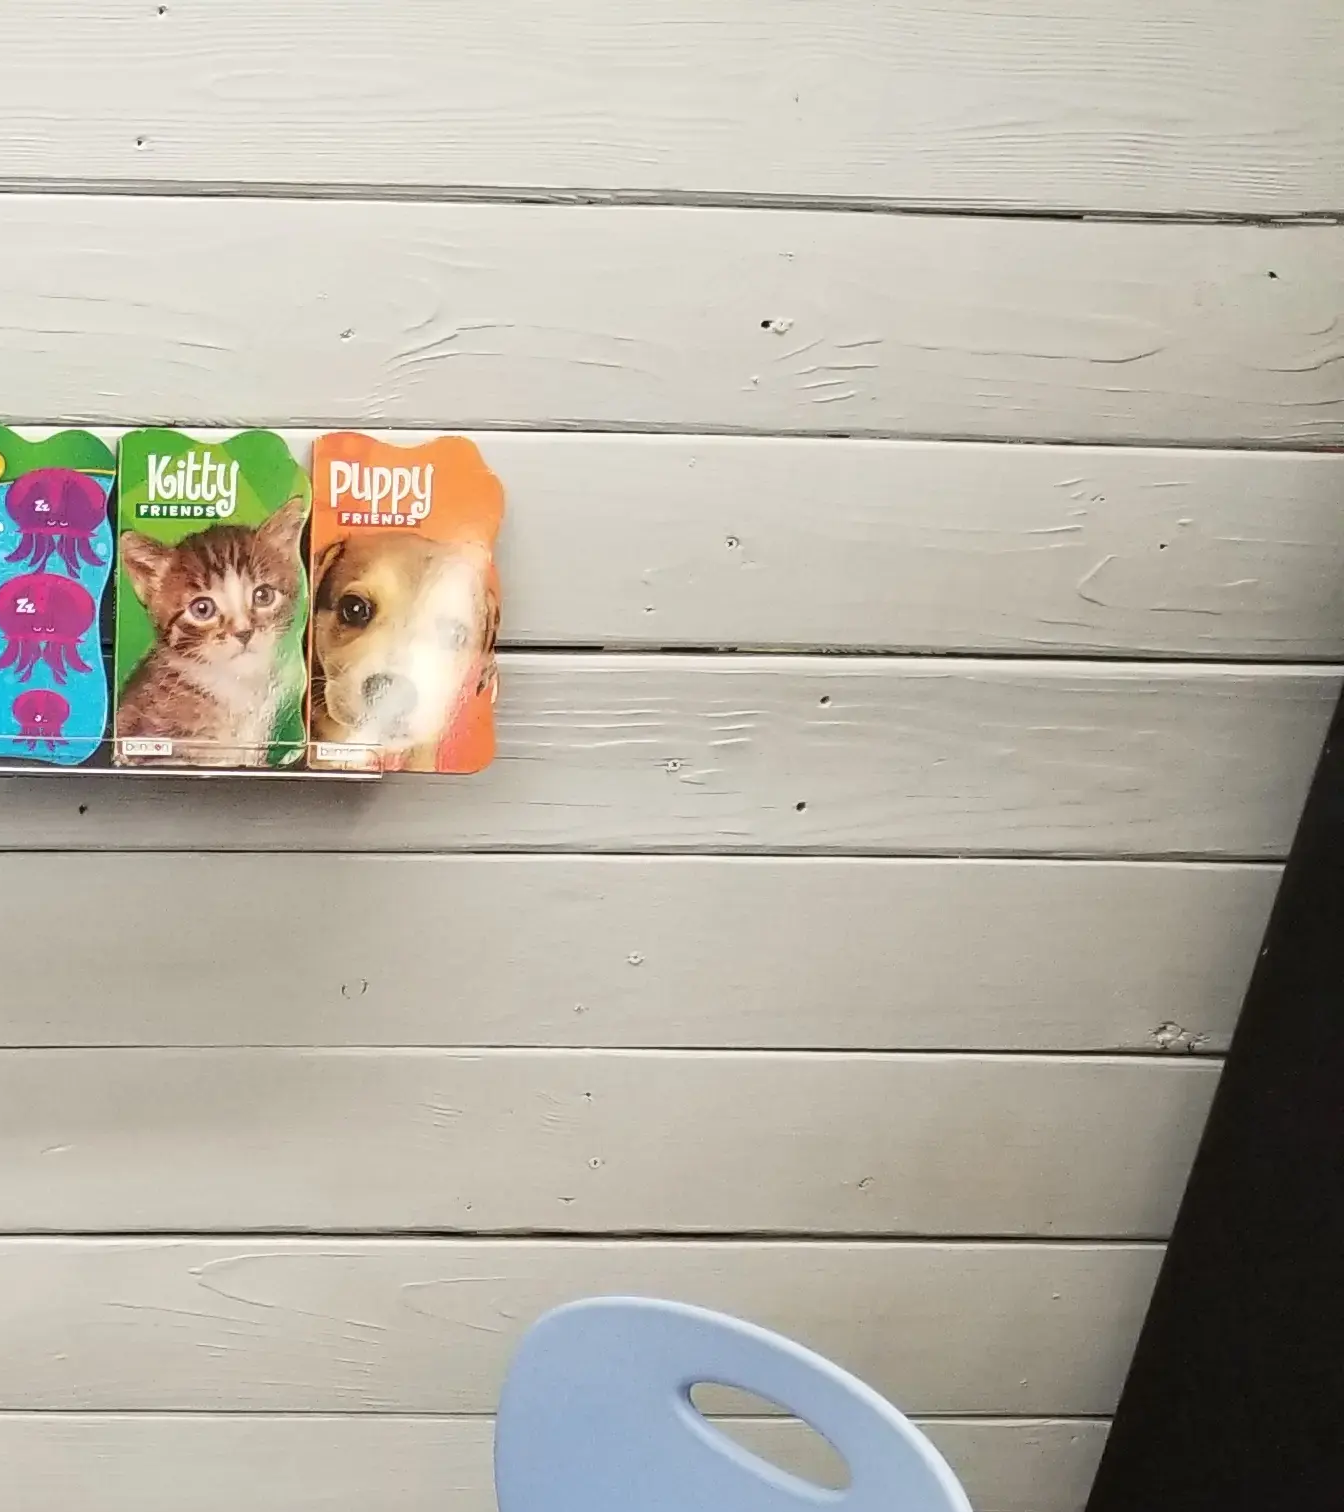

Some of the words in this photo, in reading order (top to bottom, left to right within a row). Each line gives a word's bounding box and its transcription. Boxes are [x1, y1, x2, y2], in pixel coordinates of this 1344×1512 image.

[146, 451, 239, 517] Kitty
[140, 504, 216, 517] FRIENDS
[341, 512, 417, 525] FRIENDS
